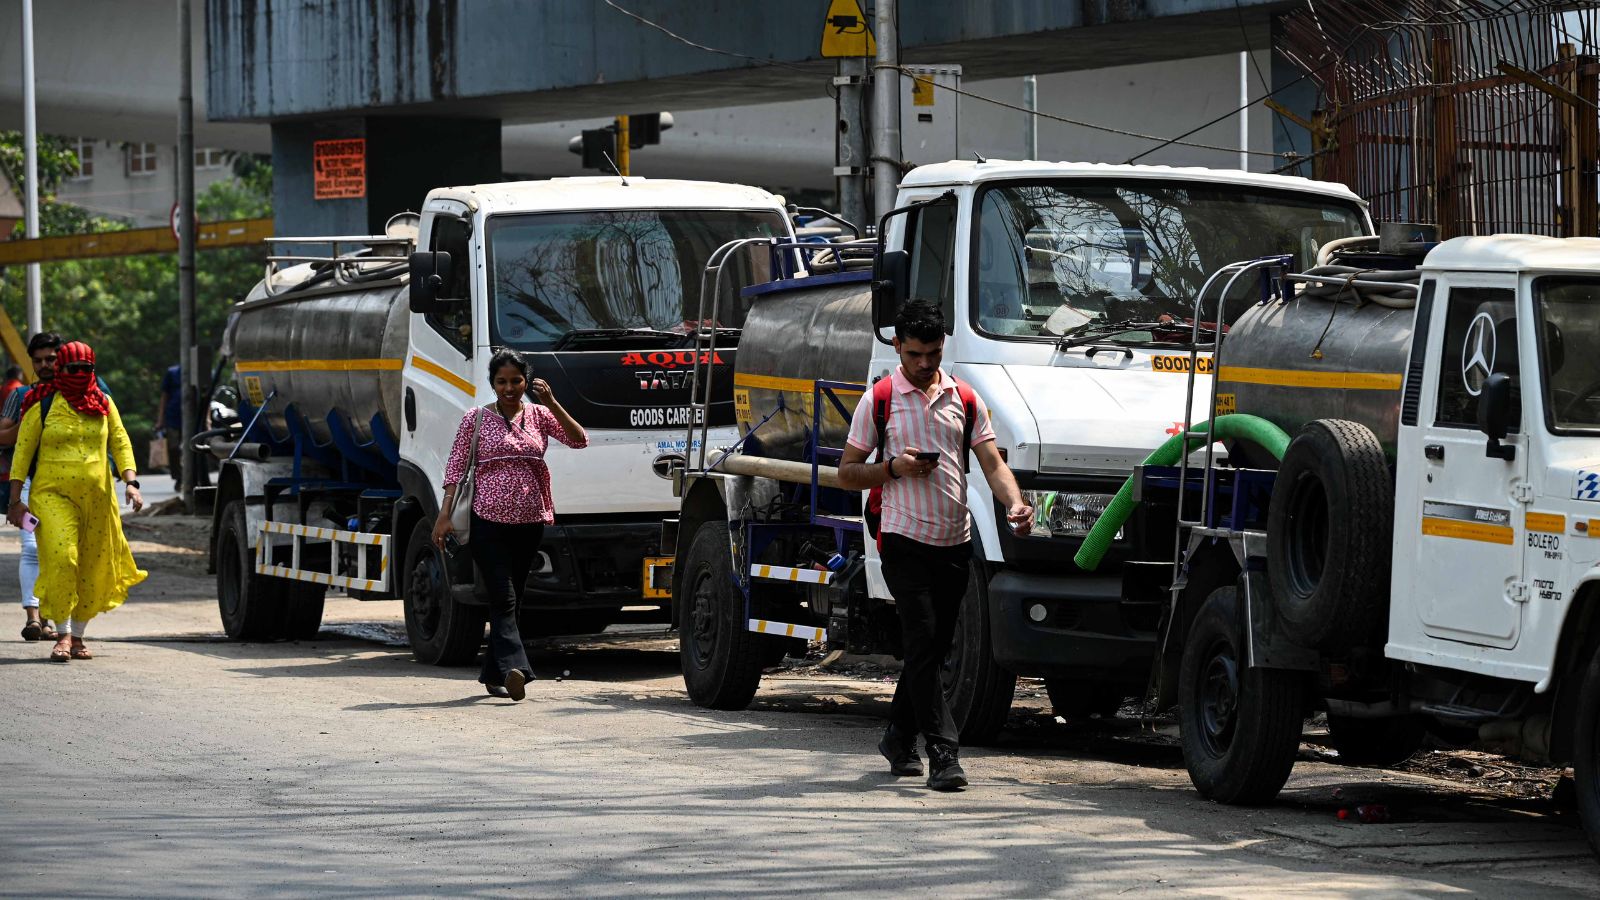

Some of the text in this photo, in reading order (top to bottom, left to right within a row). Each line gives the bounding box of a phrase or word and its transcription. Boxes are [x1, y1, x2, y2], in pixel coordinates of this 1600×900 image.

[621, 352, 724, 369] AQUA
[630, 408, 664, 426] GOODS
[657, 441, 674, 449] AMAL
[1528, 533, 1559, 550] BOLERO
